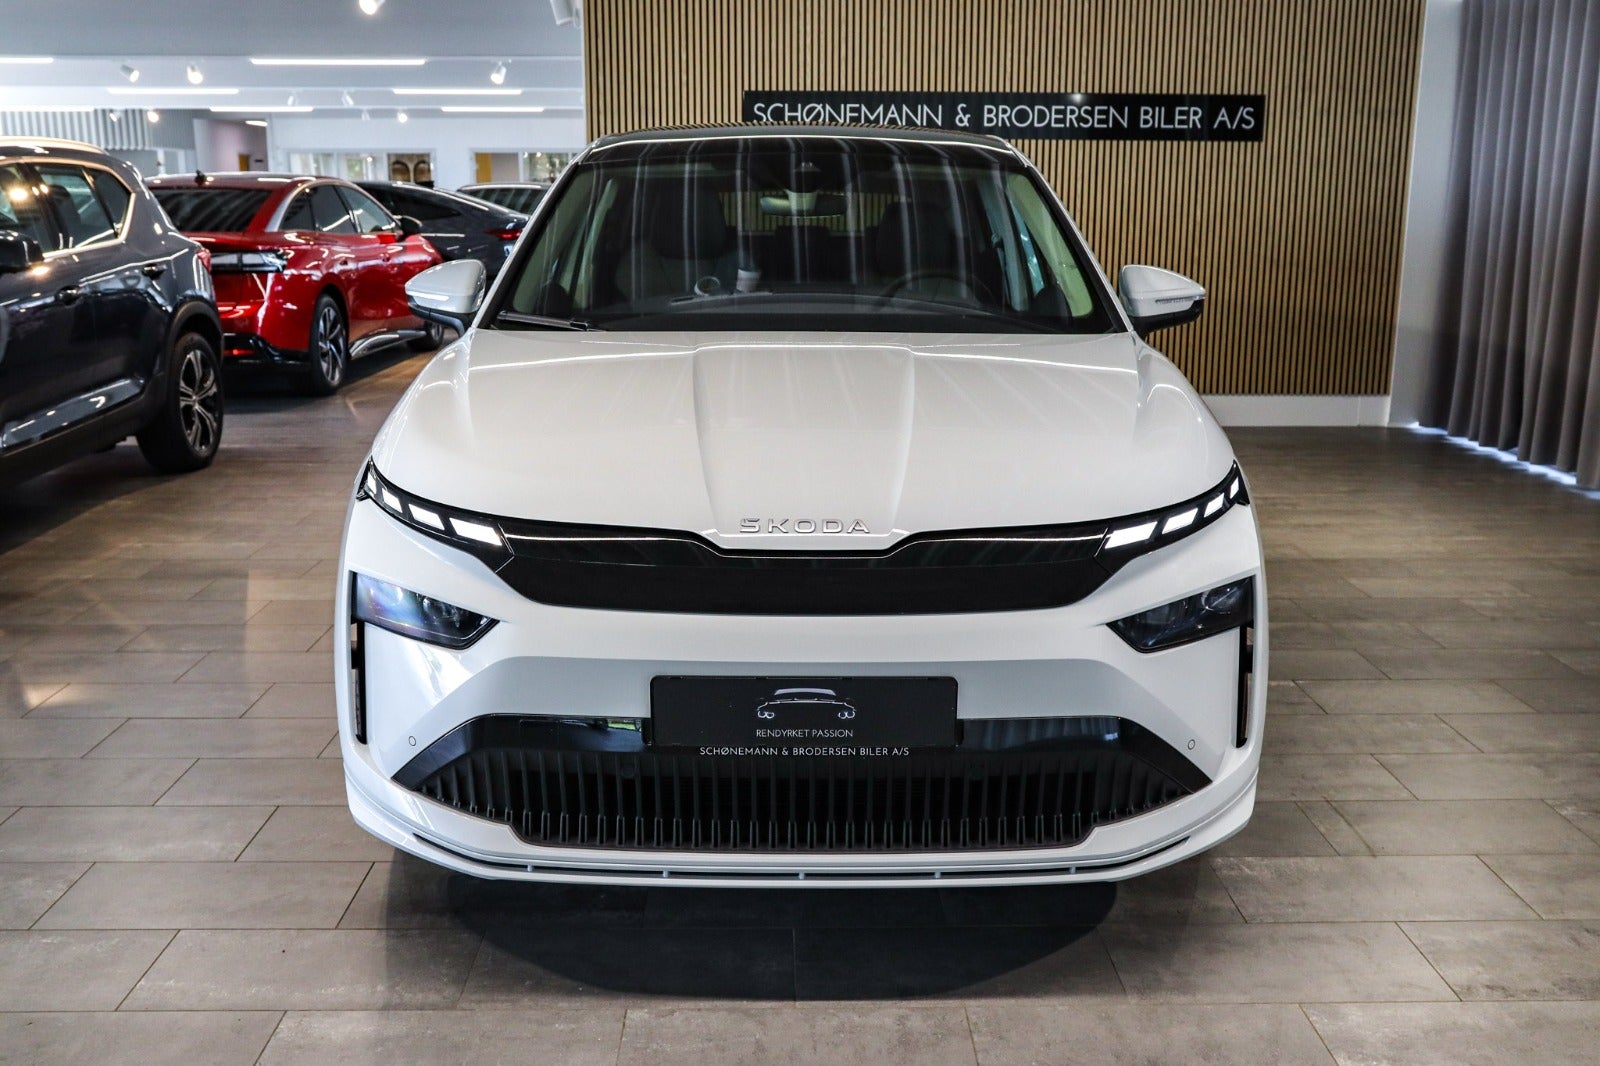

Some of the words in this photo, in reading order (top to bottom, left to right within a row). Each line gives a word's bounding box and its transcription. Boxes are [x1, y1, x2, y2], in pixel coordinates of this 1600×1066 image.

[753, 102, 943, 127] SCHØNEMANN
[955, 103, 971, 127] &
[983, 104, 1129, 129] BRODERSEN
[1140, 106, 1203, 129] BILER
[1213, 107, 1256, 130] A/S
[756, 729, 810, 738] RENDYRKET
[812, 729, 854, 738] PASSION
[699, 747, 778, 756] SCHØNEMANN
[781, 747, 789, 756] &
[792, 747, 856, 756] BRODERSEN
[860, 747, 888, 756] BILER
[892, 747, 910, 756] A/S
